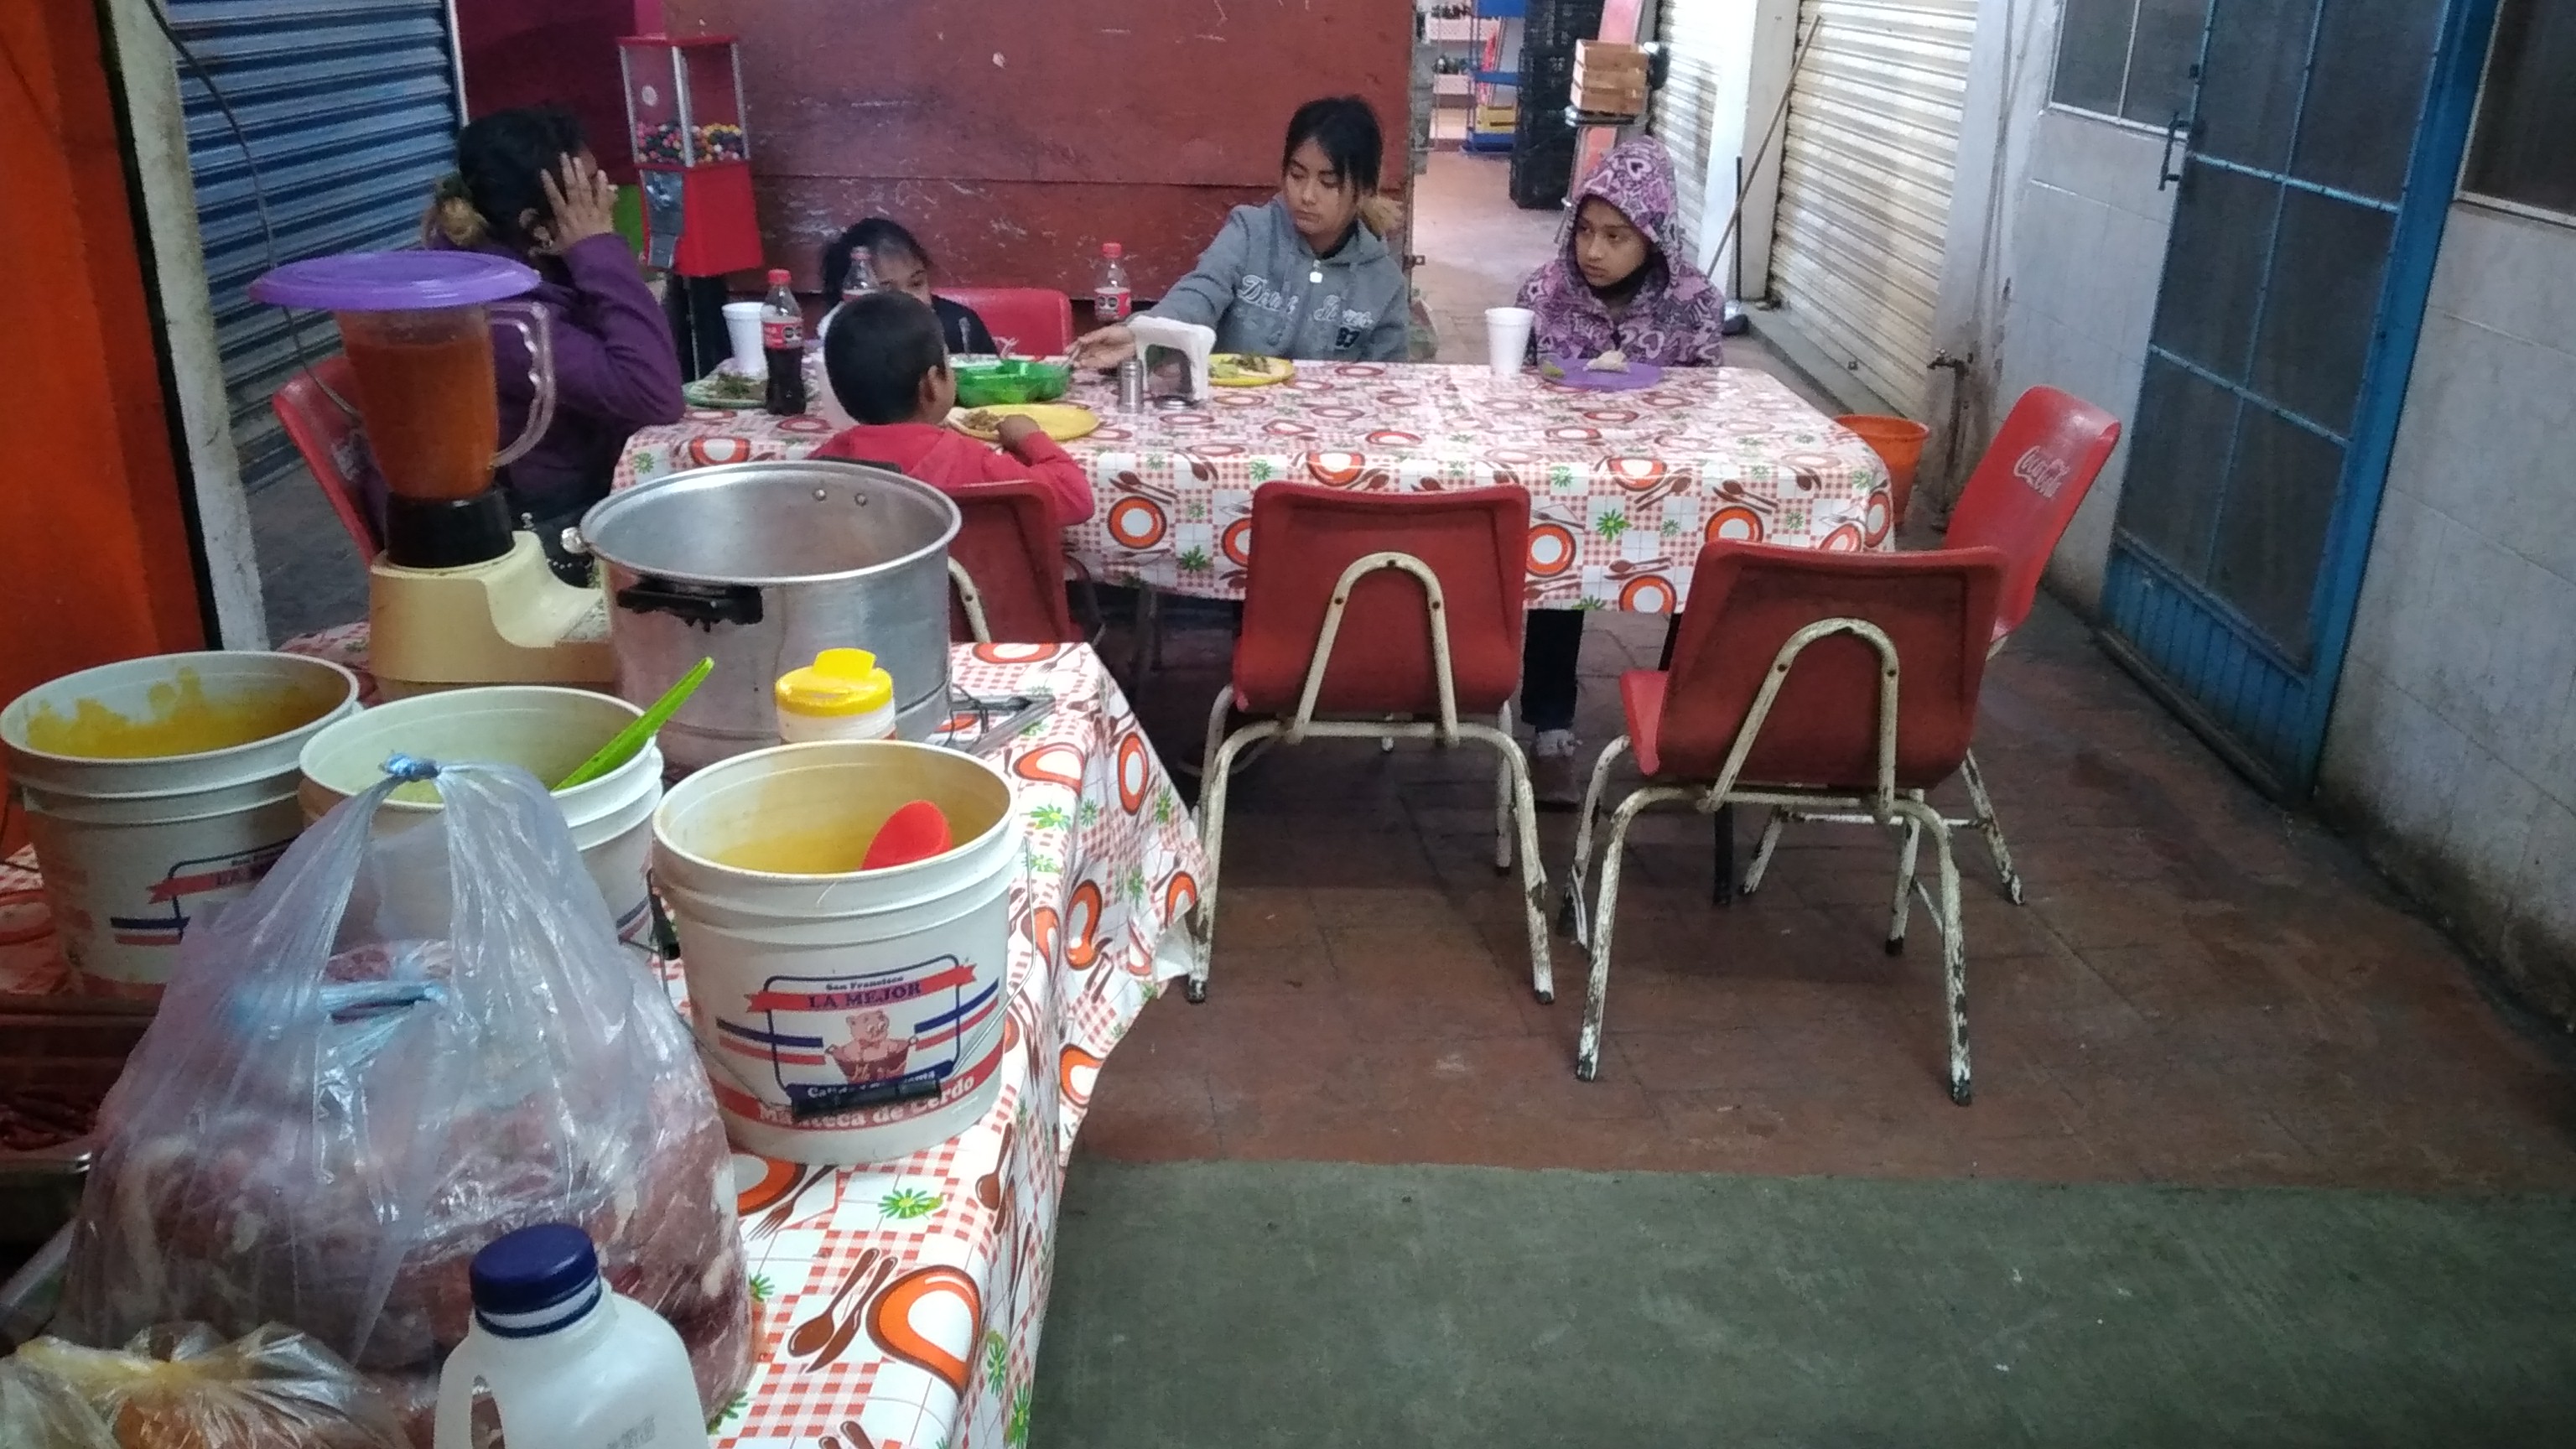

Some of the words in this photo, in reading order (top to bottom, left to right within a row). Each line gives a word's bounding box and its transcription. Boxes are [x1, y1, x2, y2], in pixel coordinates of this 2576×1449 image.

[808, 995, 838, 1008] LA
[845, 982, 922, 1006] MEJOR
[872, 1104, 904, 1124] de
